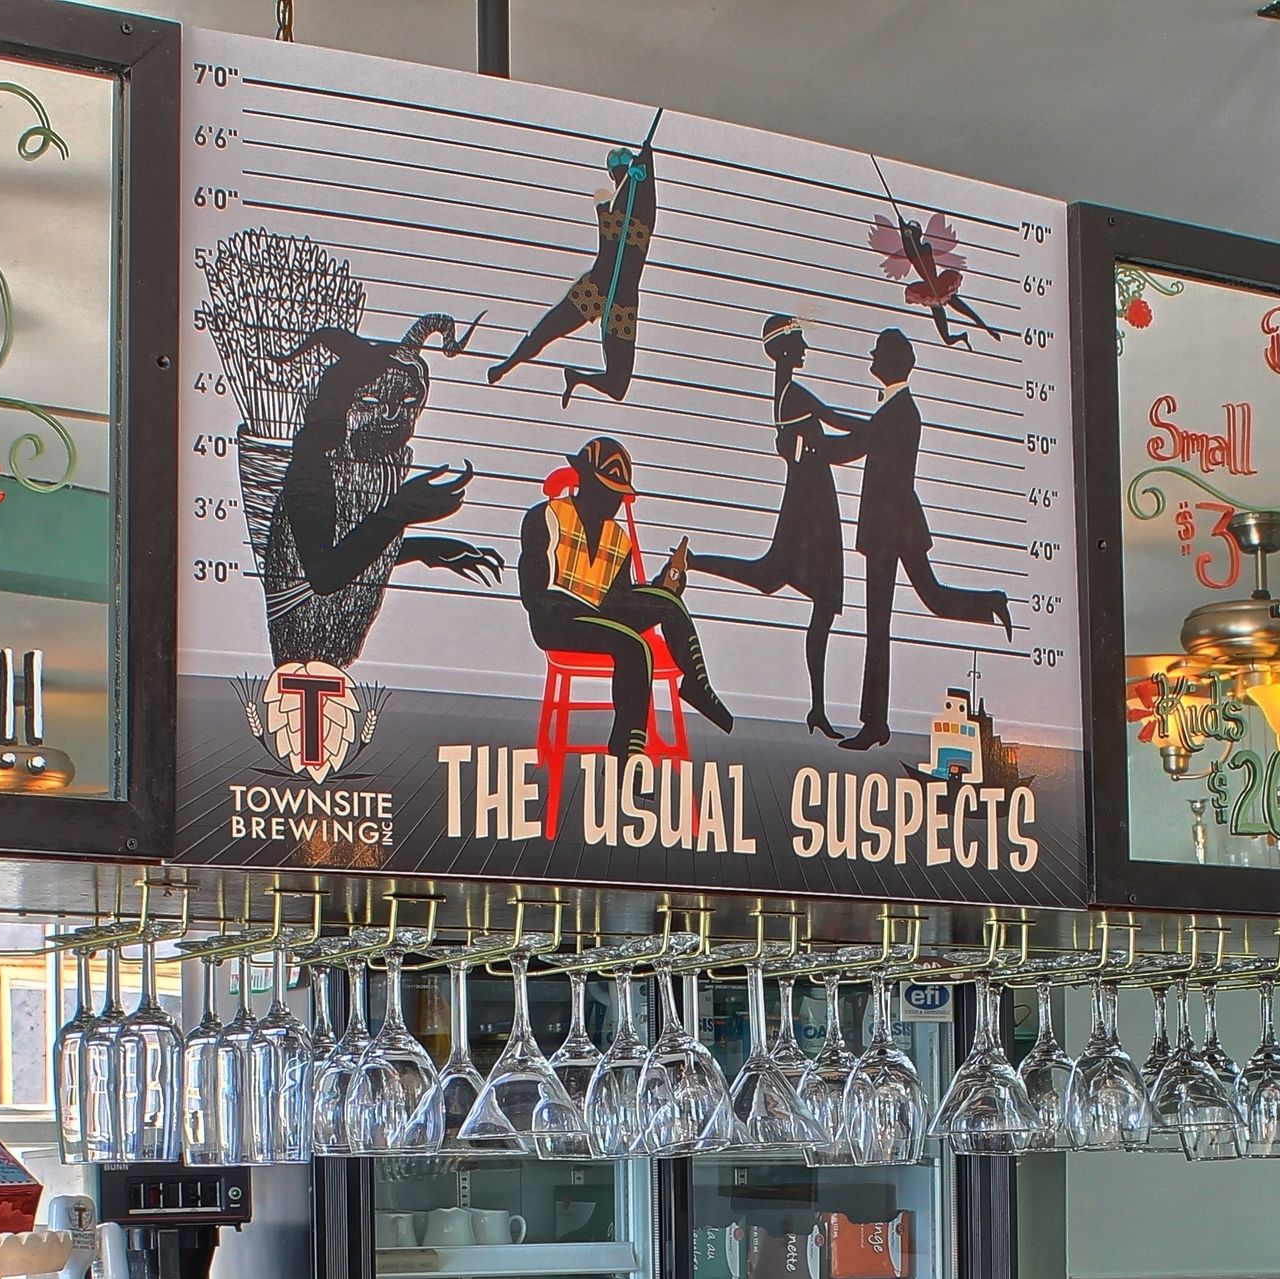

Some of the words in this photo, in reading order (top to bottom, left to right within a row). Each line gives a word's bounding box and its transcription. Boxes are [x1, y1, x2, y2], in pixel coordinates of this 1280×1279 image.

[1147, 395, 1258, 477] Small
[1177, 501, 1242, 590] $3
[277, 672, 346, 767] T
[1151, 671, 1249, 754] Kids
[229, 785, 393, 819] TOWNSITE
[438, 745, 543, 842] THE
[581, 752, 757, 855] USUAL
[791, 766, 1040, 873] SUSPECTS
[231, 816, 380, 844] BREWING
[382, 821, 393, 846] INC
[910, 985, 941, 1006] efi
[868, 1023, 912, 1037] OSIS
[786, 1233, 798, 1273] nette
[868, 1222, 884, 1253] nge
